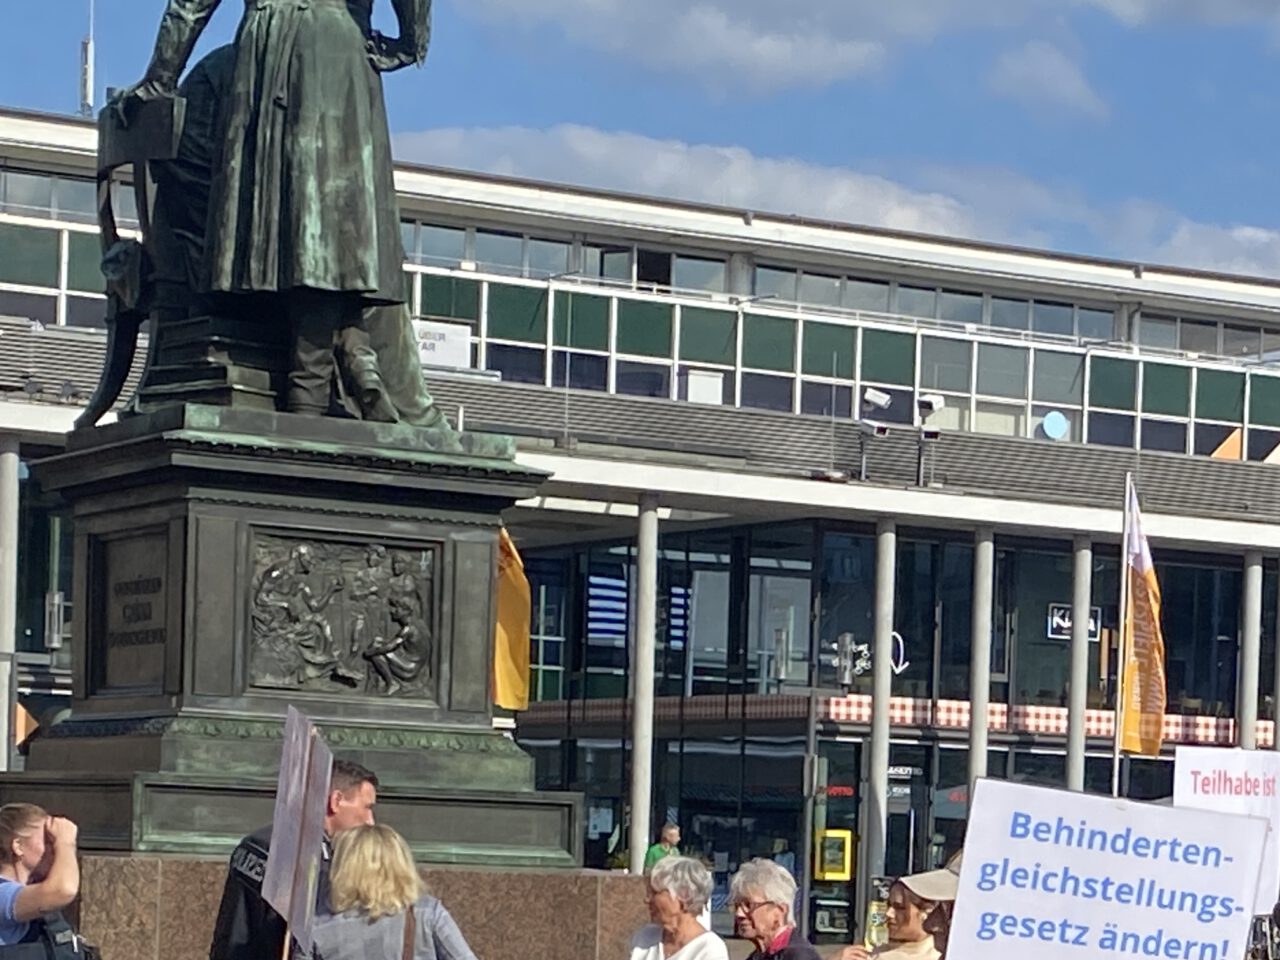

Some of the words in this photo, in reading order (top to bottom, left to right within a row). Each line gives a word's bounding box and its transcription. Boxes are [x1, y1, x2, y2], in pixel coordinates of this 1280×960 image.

[1190, 770, 1260, 796] Teilhabe
[1262, 771, 1276, 797] ist
[1010, 811, 1234, 868] Behinderten-
[976, 858, 1244, 923] gleichstellungs-
[976, 910, 1089, 941] gesetz
